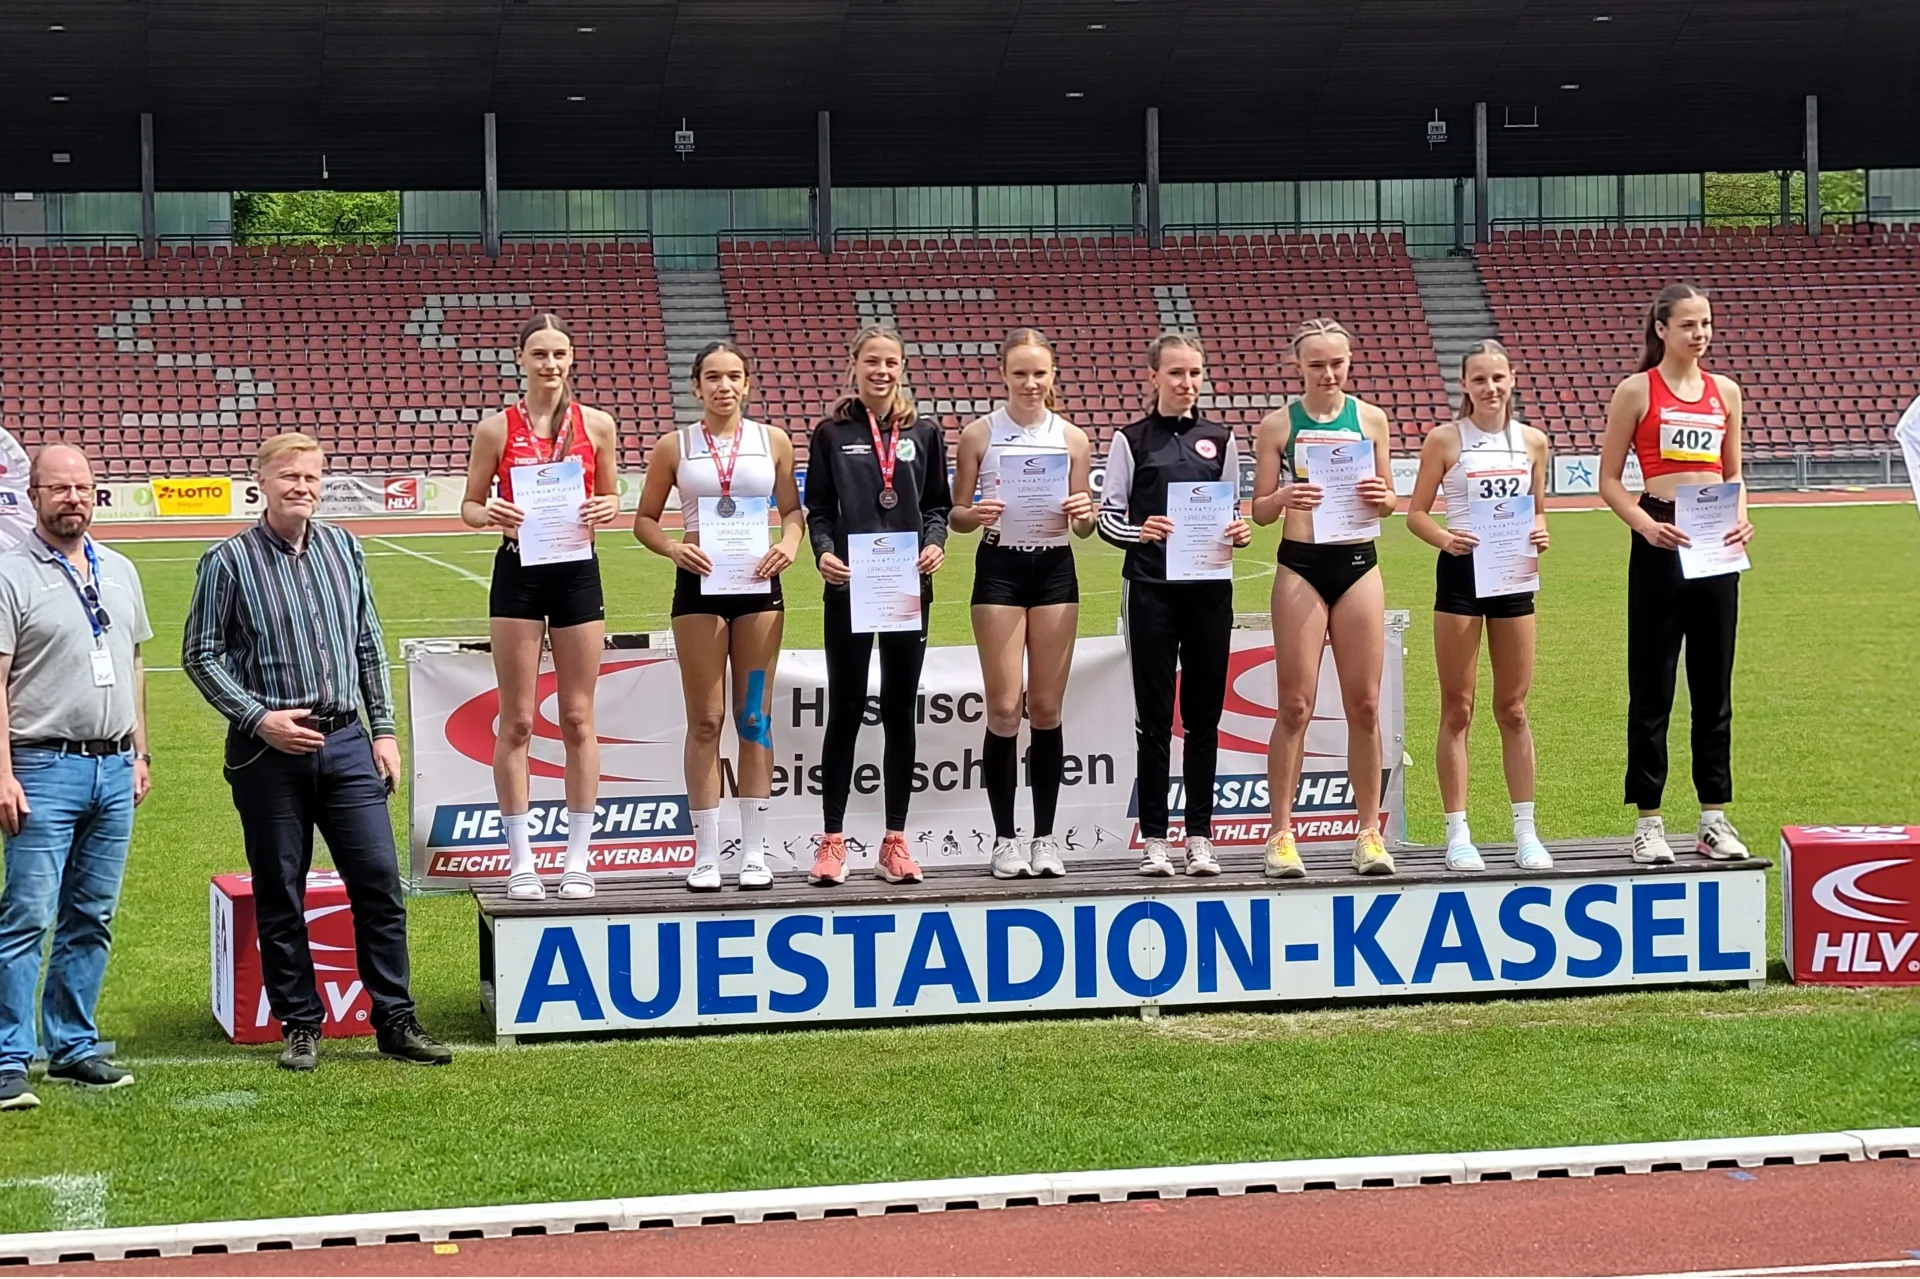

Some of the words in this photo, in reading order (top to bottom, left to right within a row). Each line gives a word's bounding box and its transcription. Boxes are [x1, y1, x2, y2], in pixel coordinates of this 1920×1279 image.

[1671, 429, 1712, 451] 402
[178, 487, 223, 498] LOTTO
[1479, 477, 1520, 499] 332
[1489, 529, 1521, 538] URKUNDE
[867, 565, 901, 573] URKUNDE
[514, 881, 1751, 1024] AUESTADION-KASSEL
